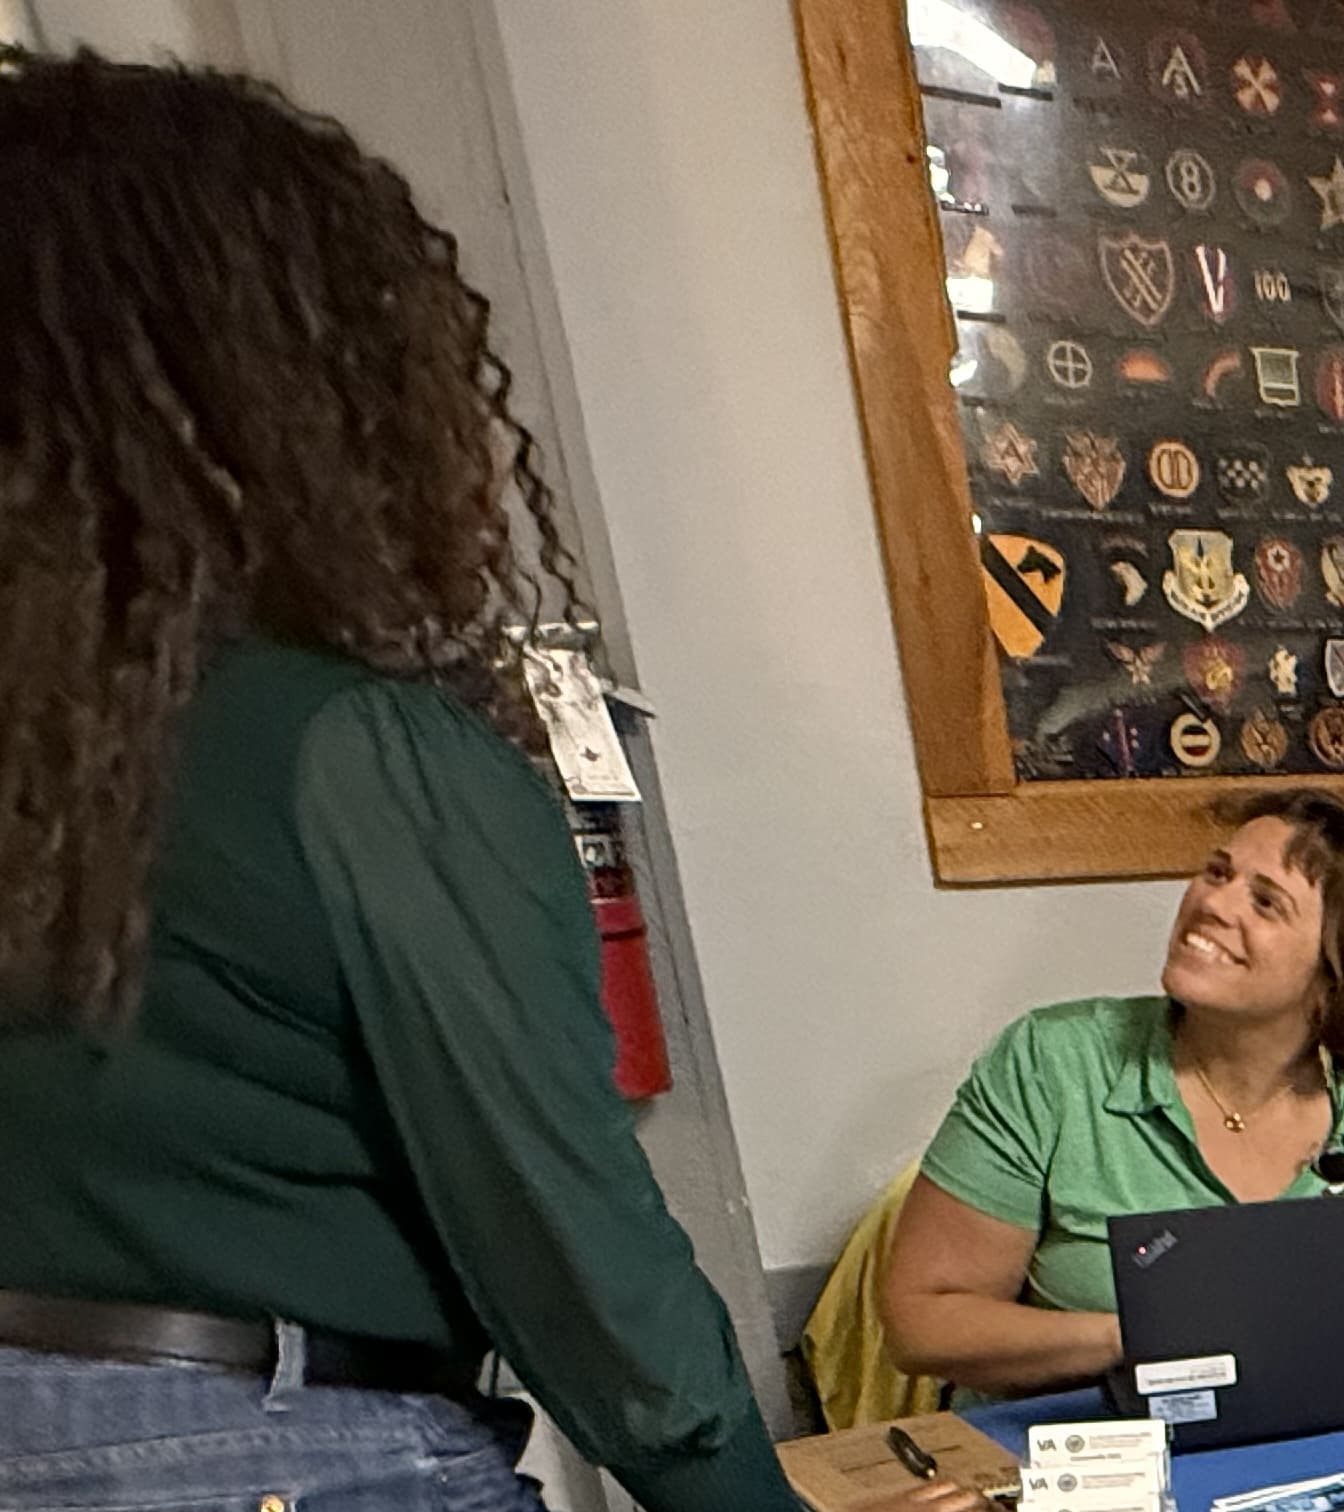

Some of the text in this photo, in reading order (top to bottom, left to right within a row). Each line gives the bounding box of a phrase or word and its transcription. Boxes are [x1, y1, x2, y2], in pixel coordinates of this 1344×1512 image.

[1180, 160, 1202, 201] 8
[1037, 1438, 1056, 1452] VA
[1028, 1477, 1048, 1491] VA
